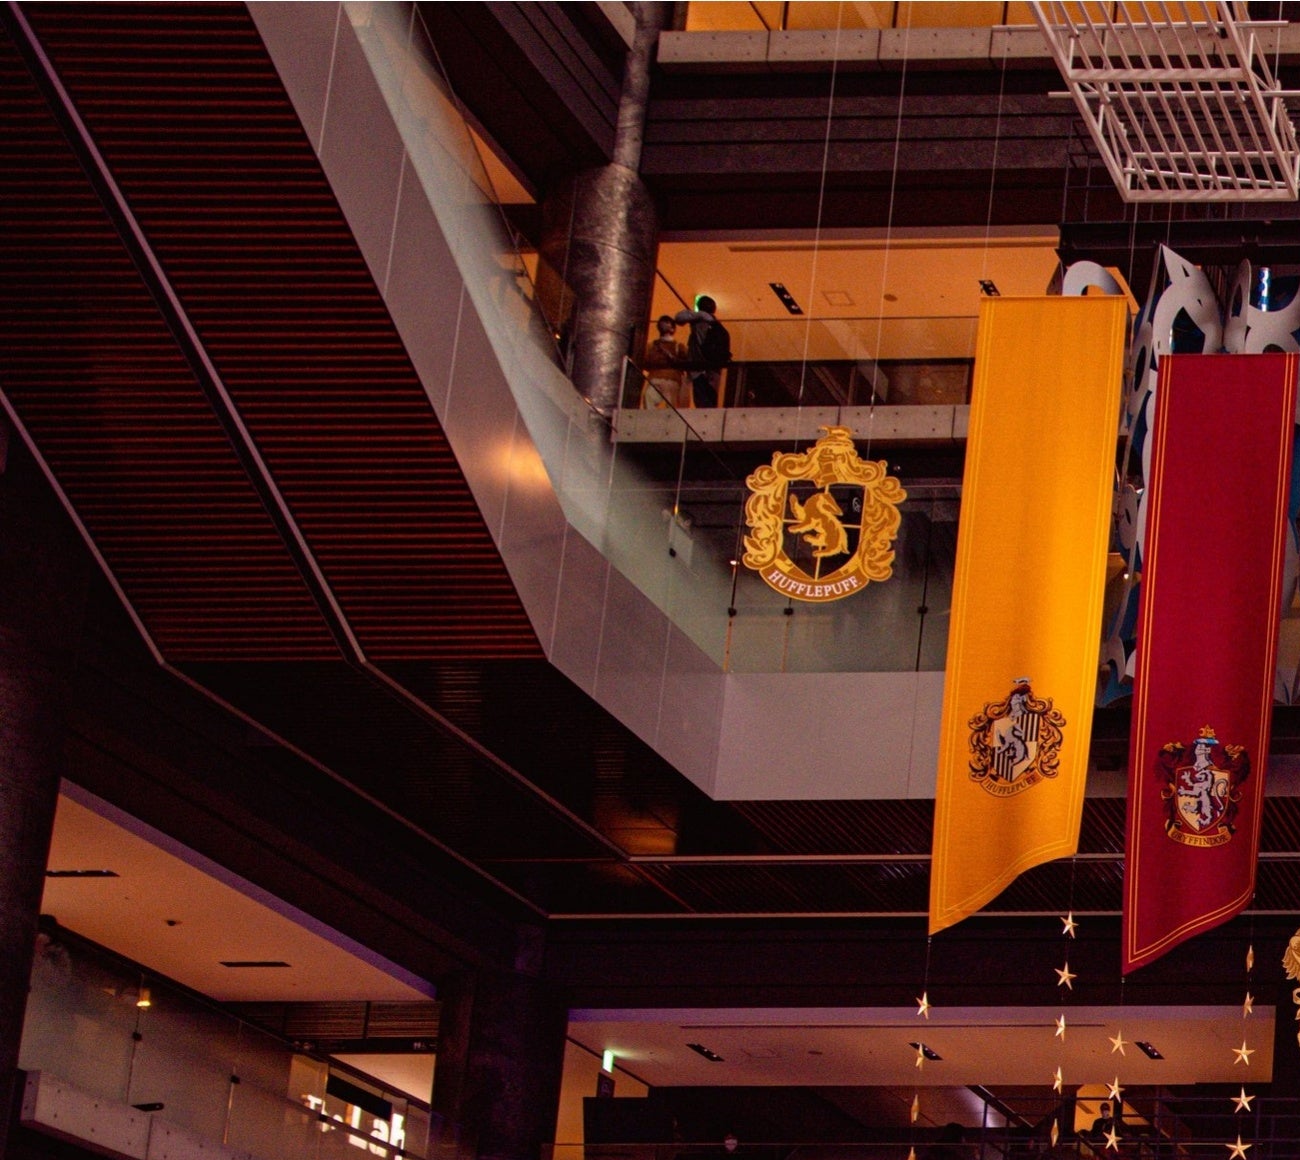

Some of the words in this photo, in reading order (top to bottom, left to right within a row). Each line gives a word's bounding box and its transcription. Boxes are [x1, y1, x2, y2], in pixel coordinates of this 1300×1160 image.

[767, 570, 860, 597] HUFFLEPUFF
[985, 773, 1038, 796] HUFFLEPUFF
[1171, 832, 1229, 847] GRYFFINDOR
